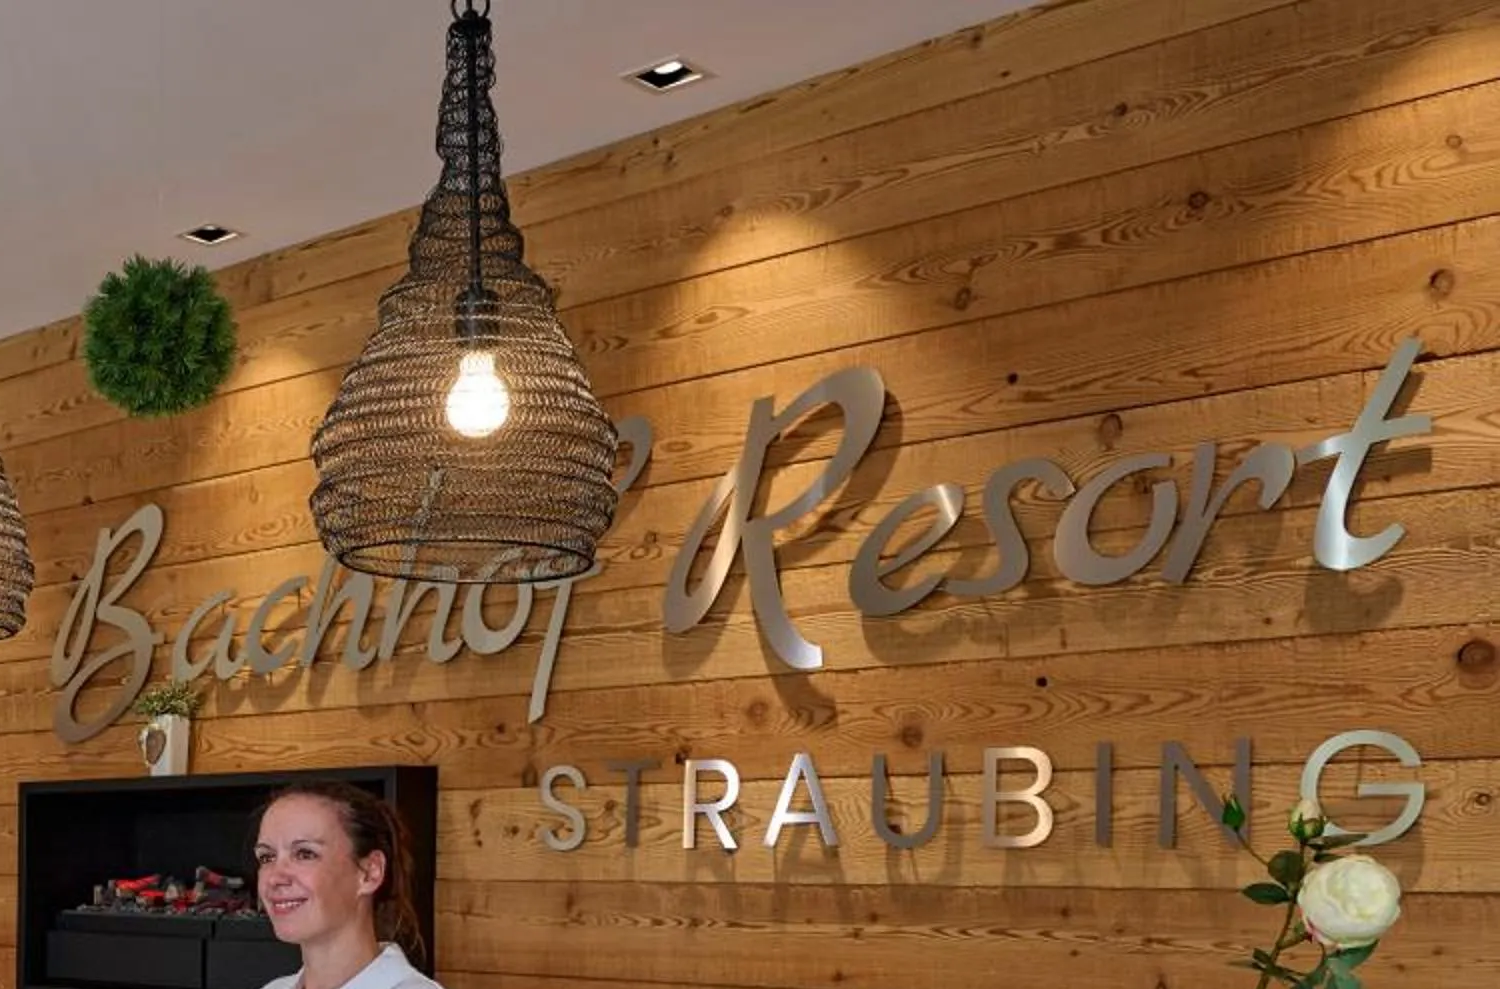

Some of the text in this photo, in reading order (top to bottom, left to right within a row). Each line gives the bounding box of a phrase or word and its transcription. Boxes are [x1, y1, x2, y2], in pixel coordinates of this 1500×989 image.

[50, 337, 1432, 744] Bachhof Resort
[539, 729, 1425, 851] STRAUBING
